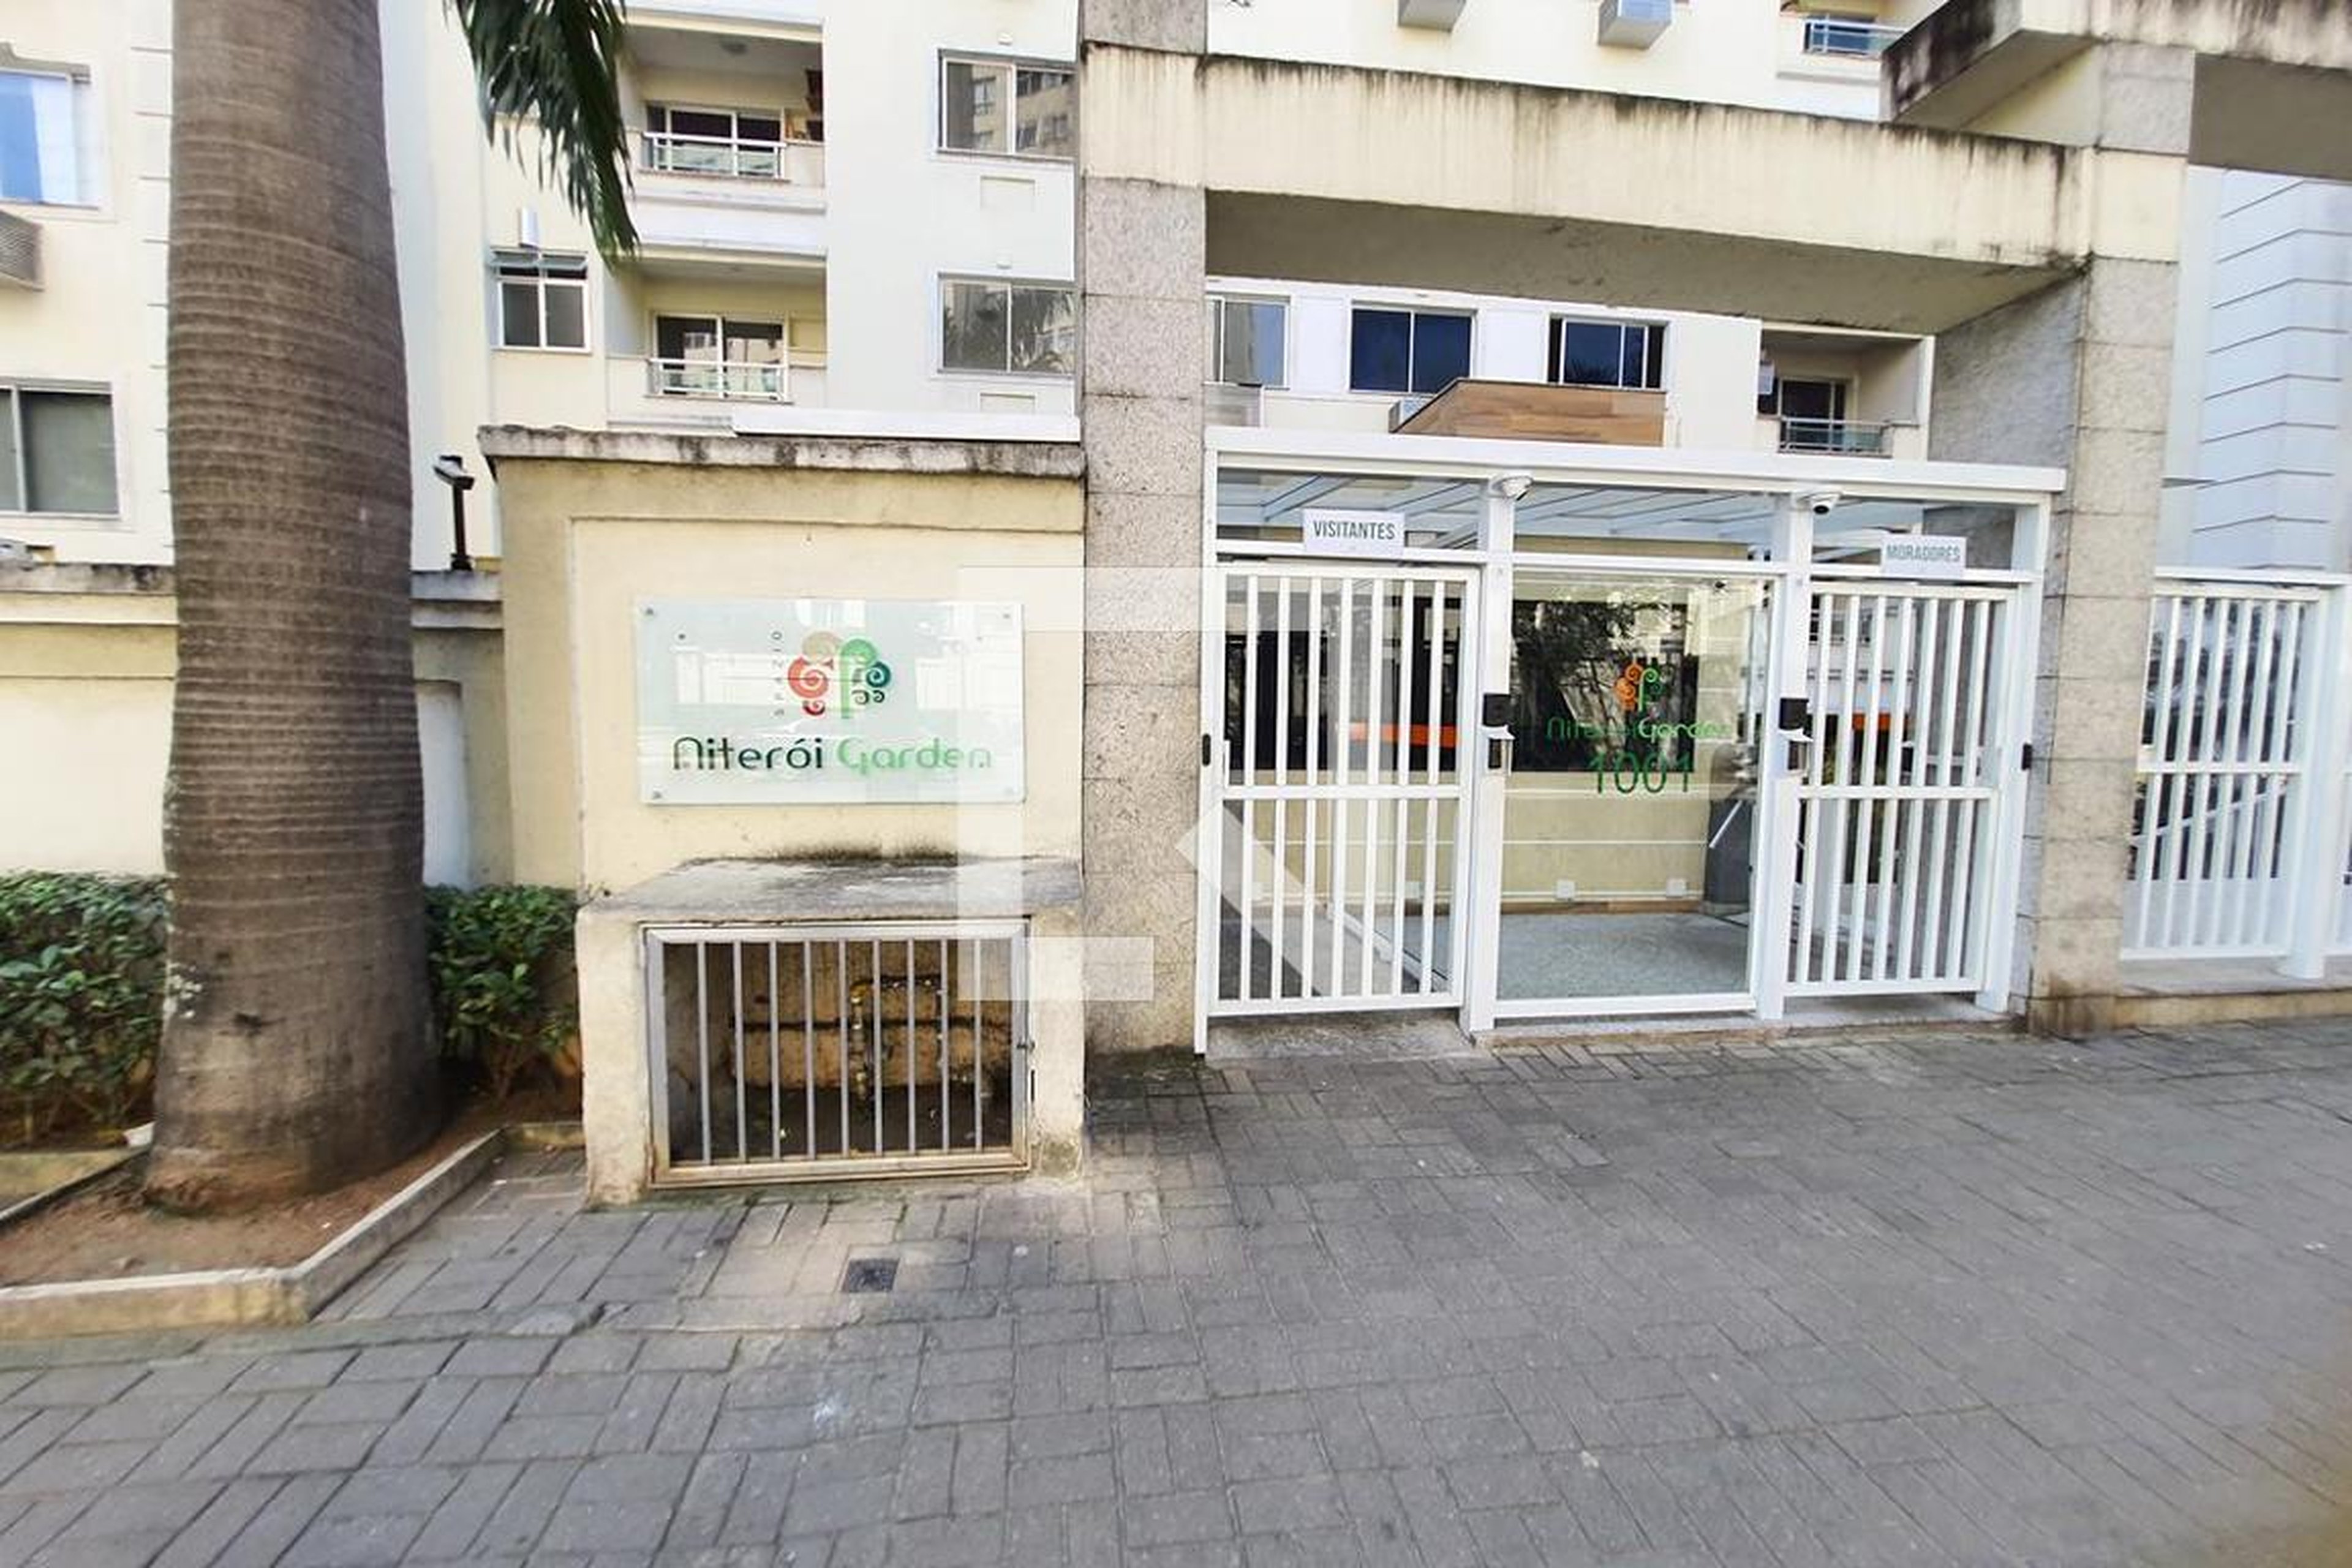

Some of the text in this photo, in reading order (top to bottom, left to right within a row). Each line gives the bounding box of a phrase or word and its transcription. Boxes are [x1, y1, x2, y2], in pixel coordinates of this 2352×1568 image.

[1313, 521, 1395, 540] VISITANTES
[837, 737, 991, 775] Garden
[1589, 752, 1693, 794] 1001
